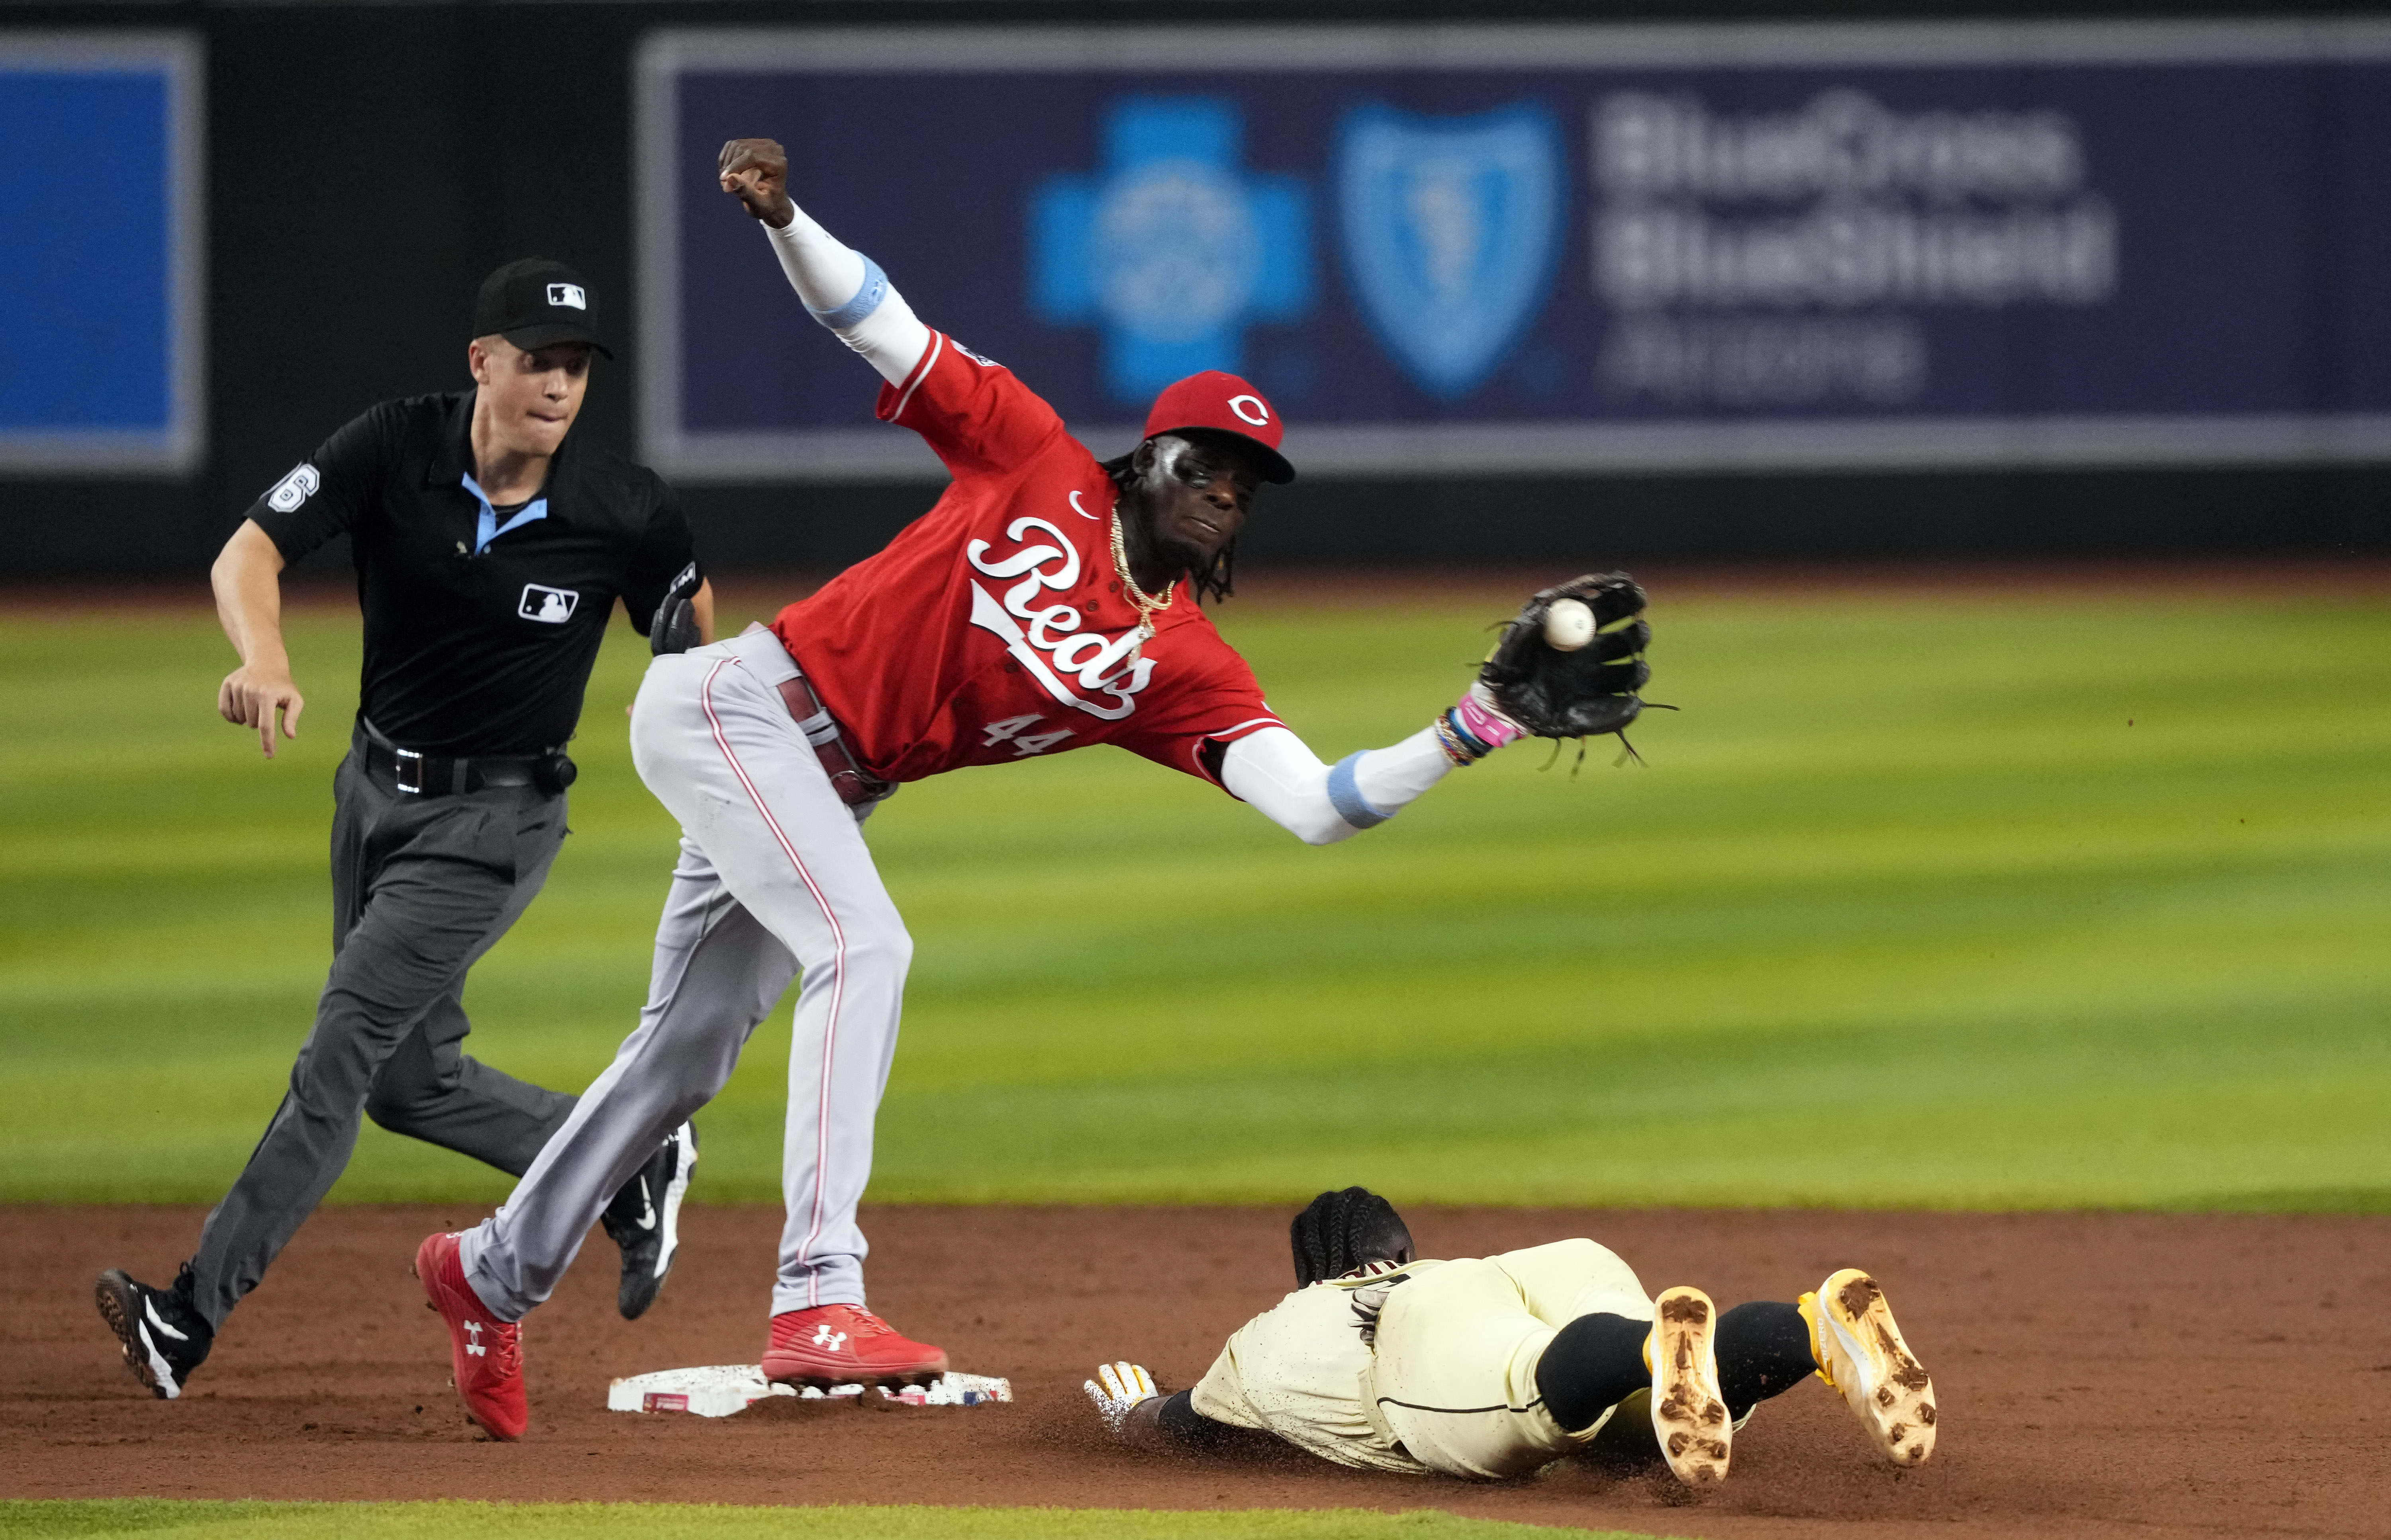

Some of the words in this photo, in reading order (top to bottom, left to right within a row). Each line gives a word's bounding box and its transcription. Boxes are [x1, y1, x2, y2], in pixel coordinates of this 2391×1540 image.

[1595, 92, 2077, 195] BlueCross
[1595, 199, 2113, 303] BlueShield
[1227, 395, 1270, 427] C
[263, 461, 320, 513] 6
[967, 517, 1158, 720] Reds
[980, 712, 1078, 756] 44
